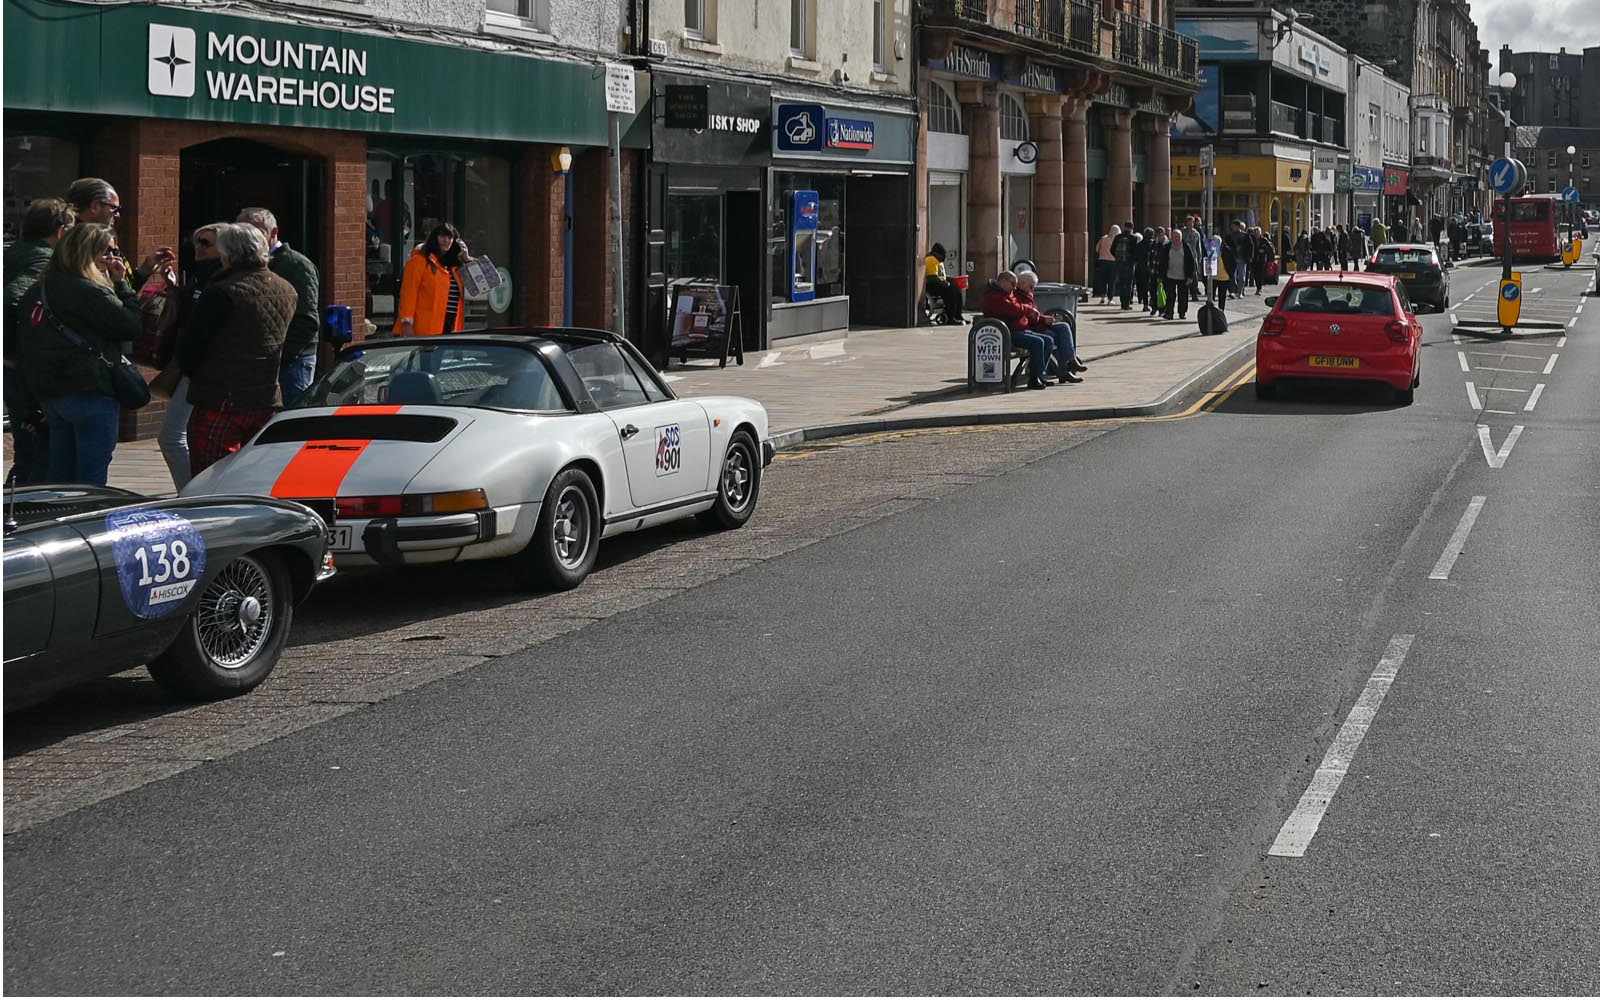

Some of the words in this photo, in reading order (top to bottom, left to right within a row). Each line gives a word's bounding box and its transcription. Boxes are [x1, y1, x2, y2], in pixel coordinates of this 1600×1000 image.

[207, 31, 367, 76] MOUNTAIN
[206, 70, 395, 114] WAREHOUSE
[736, 116, 760, 134] SHOP
[839, 123, 873, 143] Nationwide
[977, 344, 1001, 354] WiFi
[665, 426, 680, 448] SOS
[664, 447, 680, 471] 901
[134, 539, 190, 587] 138
[158, 584, 189, 600] HISCOX
